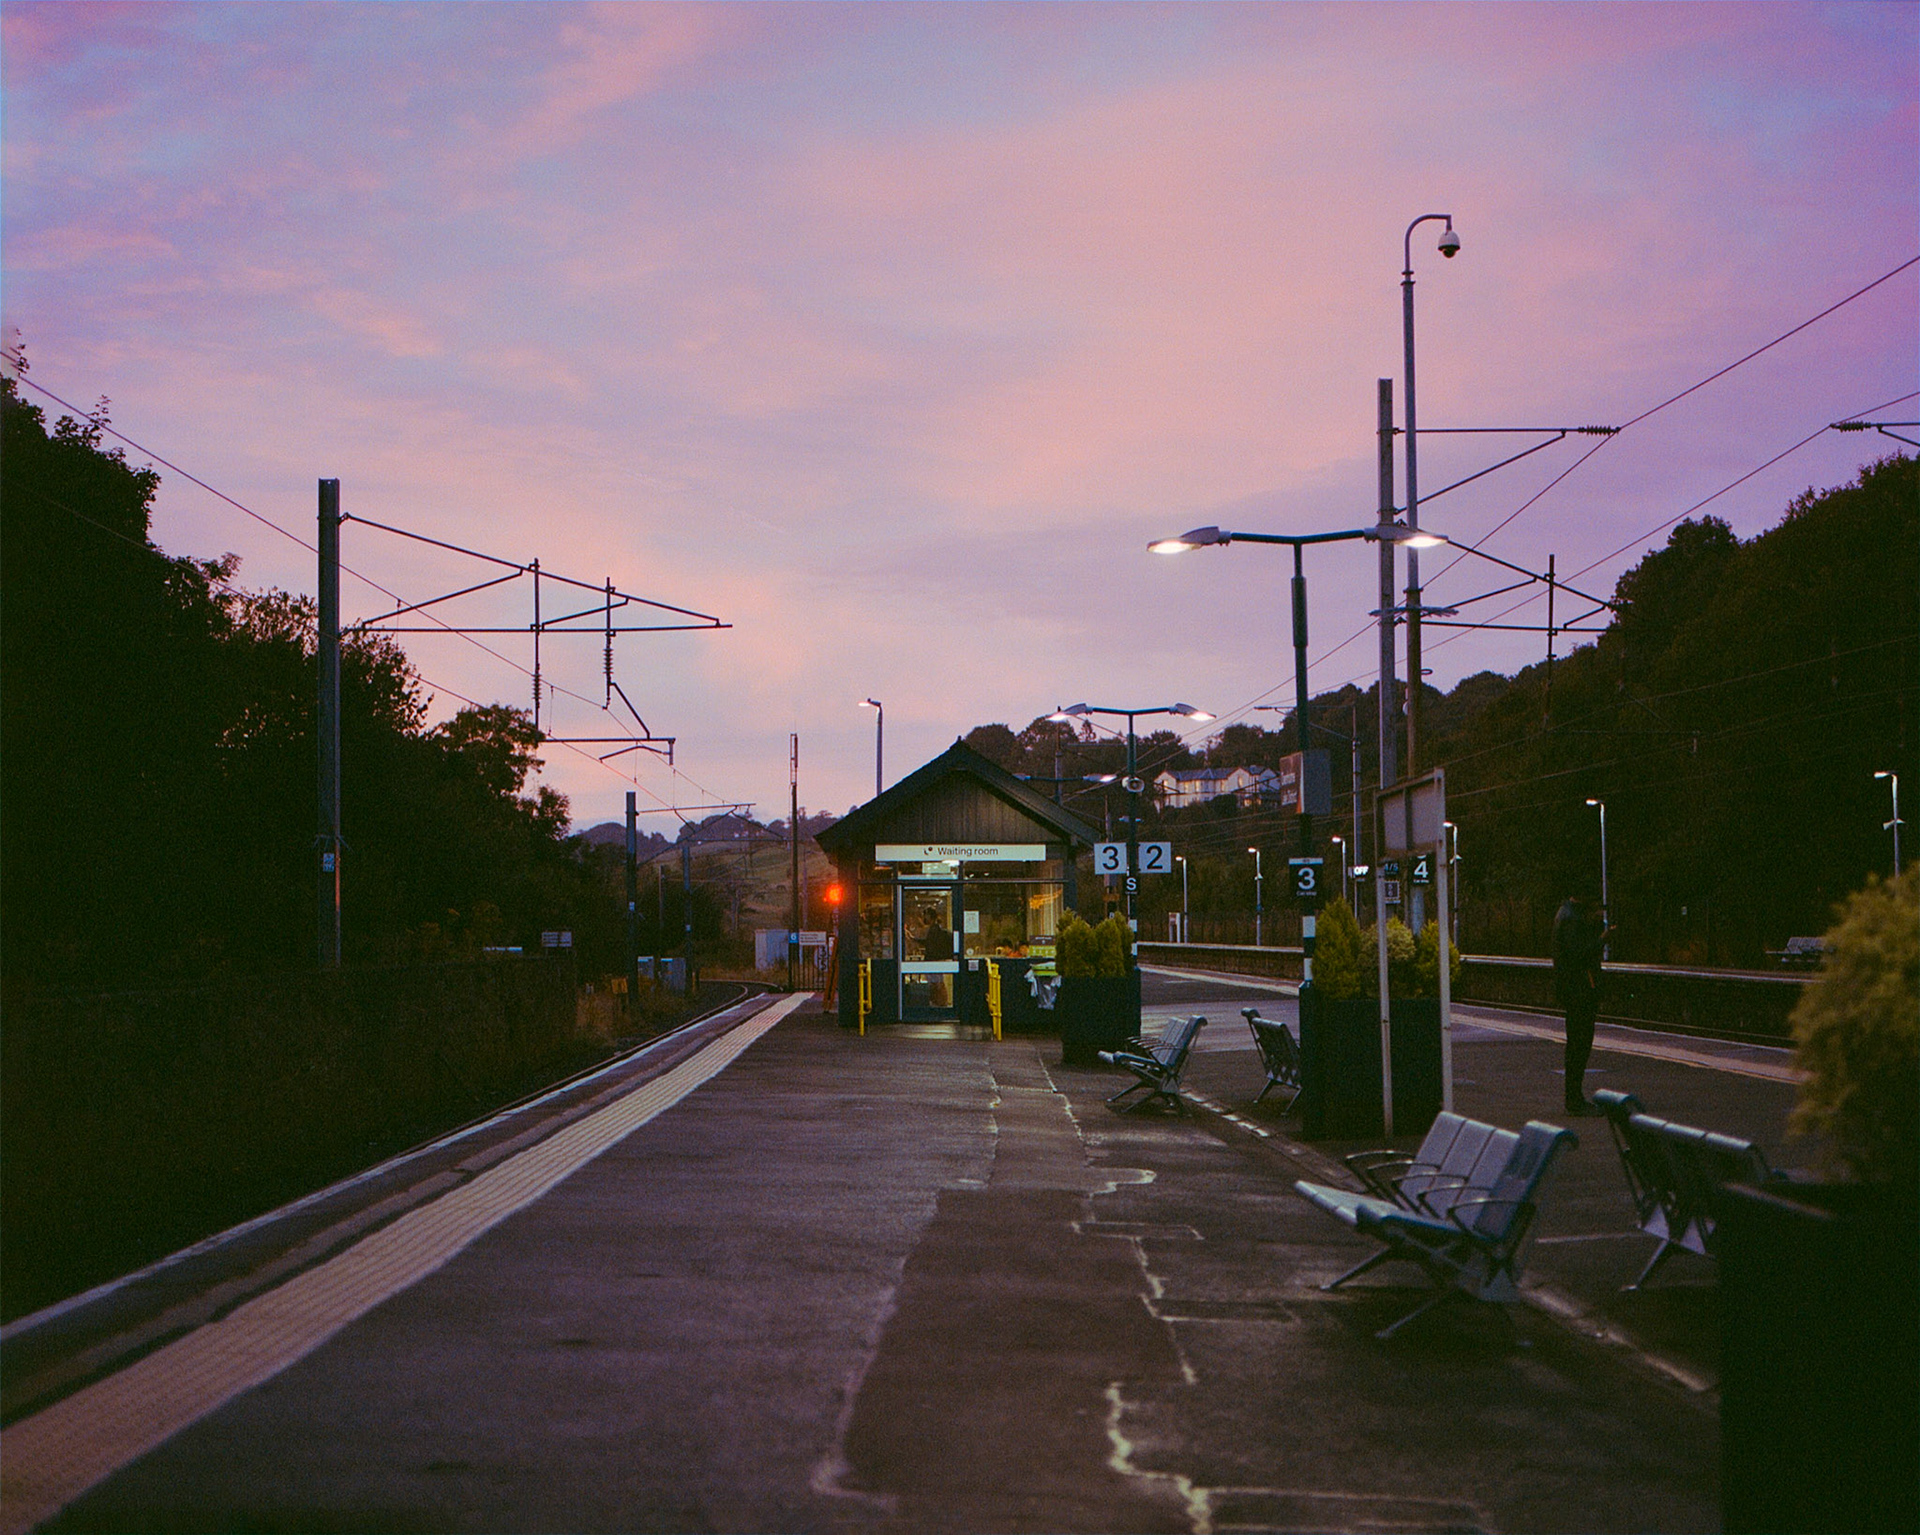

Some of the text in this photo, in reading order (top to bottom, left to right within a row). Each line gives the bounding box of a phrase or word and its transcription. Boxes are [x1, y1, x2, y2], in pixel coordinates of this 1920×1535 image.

[937, 847, 999, 857] Waiting room
[1102, 845, 1119, 870] 3
[1146, 845, 1163, 870] 2
[1298, 867, 1315, 890] 3
[1413, 860, 1428, 878] 4
[1126, 877, 1137, 891] S
